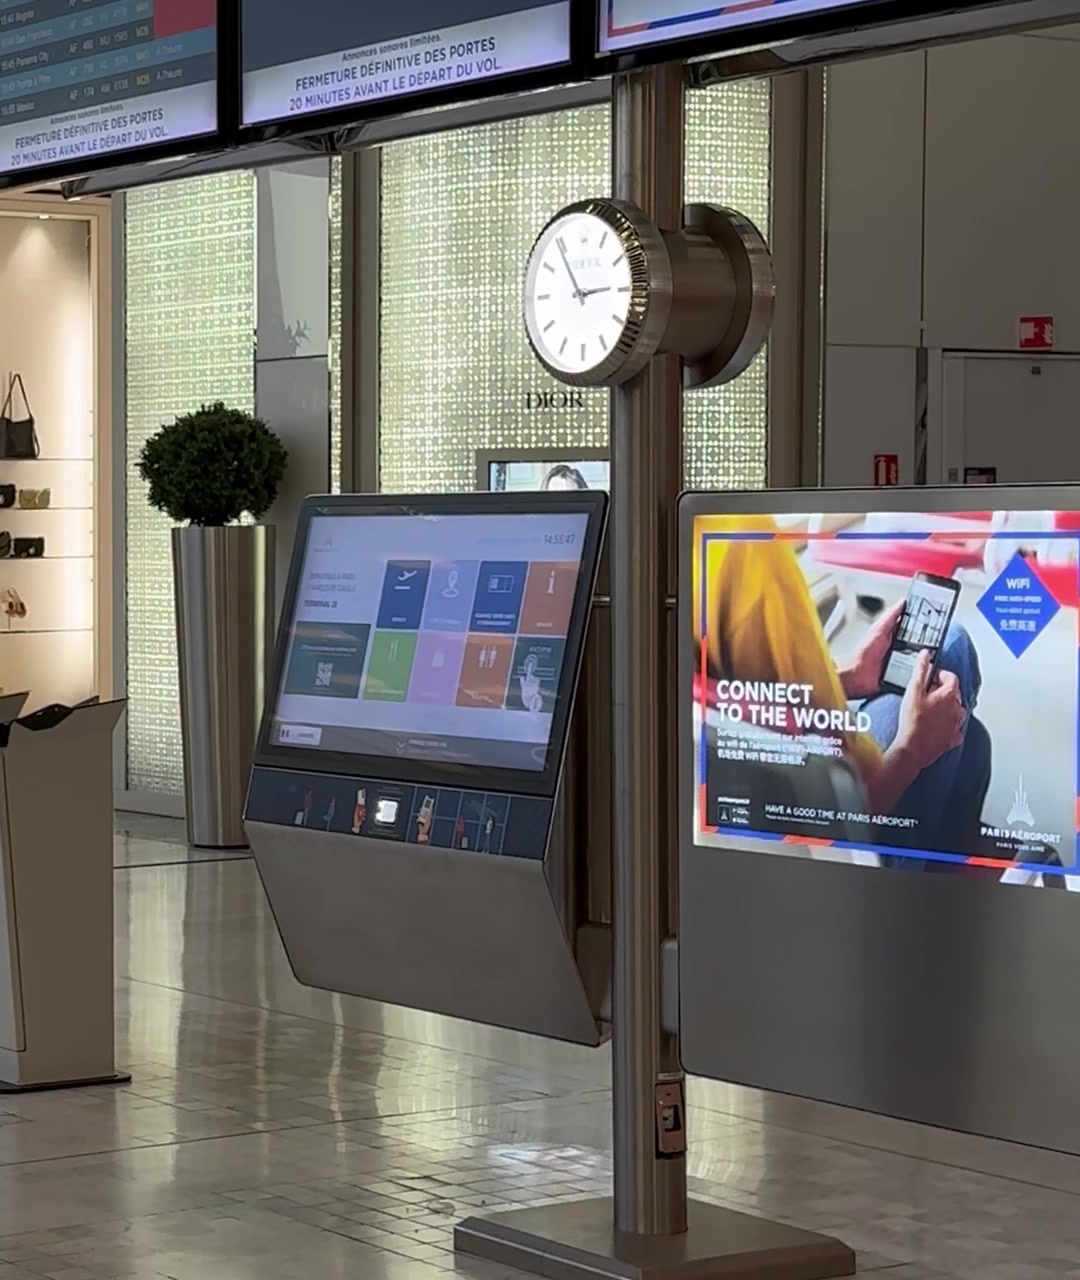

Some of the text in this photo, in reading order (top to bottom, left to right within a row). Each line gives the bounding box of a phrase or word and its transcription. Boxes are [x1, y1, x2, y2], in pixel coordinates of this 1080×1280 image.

[295, 35, 496, 91] FERMETURE DÉFINITIVE DES PORTES
[341, 45, 377, 63] Annonces
[379, 39, 408, 54] sonores
[289, 96, 302, 112] 20
[304, 86, 351, 108] MINUTES
[354, 78, 389, 98] AVANT
[392, 74, 405, 91] LE
[407, 63, 453, 88] DÉPART
[456, 61, 473, 78] DU
[14, 107, 164, 150] FERMETURE DÉFINITIVE DES PORTES
[10, 153, 21, 166] 20
[21, 146, 57, 164] MINUTES
[58, 140, 85, 157] AVANT
[87, 137, 97, 151] LE
[99, 129, 132, 149] DÉPART
[134, 128, 147, 142] DU
[526, 390, 584, 410] DIOR
[716, 680, 814, 705] CONNECT
[717, 702, 872, 733] TO THE WORLD
[764, 804, 785, 814] HAVE
[785, 806, 792, 815] A
[792, 806, 816, 818] GOOD
[816, 808, 835, 820] TIME
[835, 811, 846, 821] AT
[847, 812, 871, 824] PARIS
